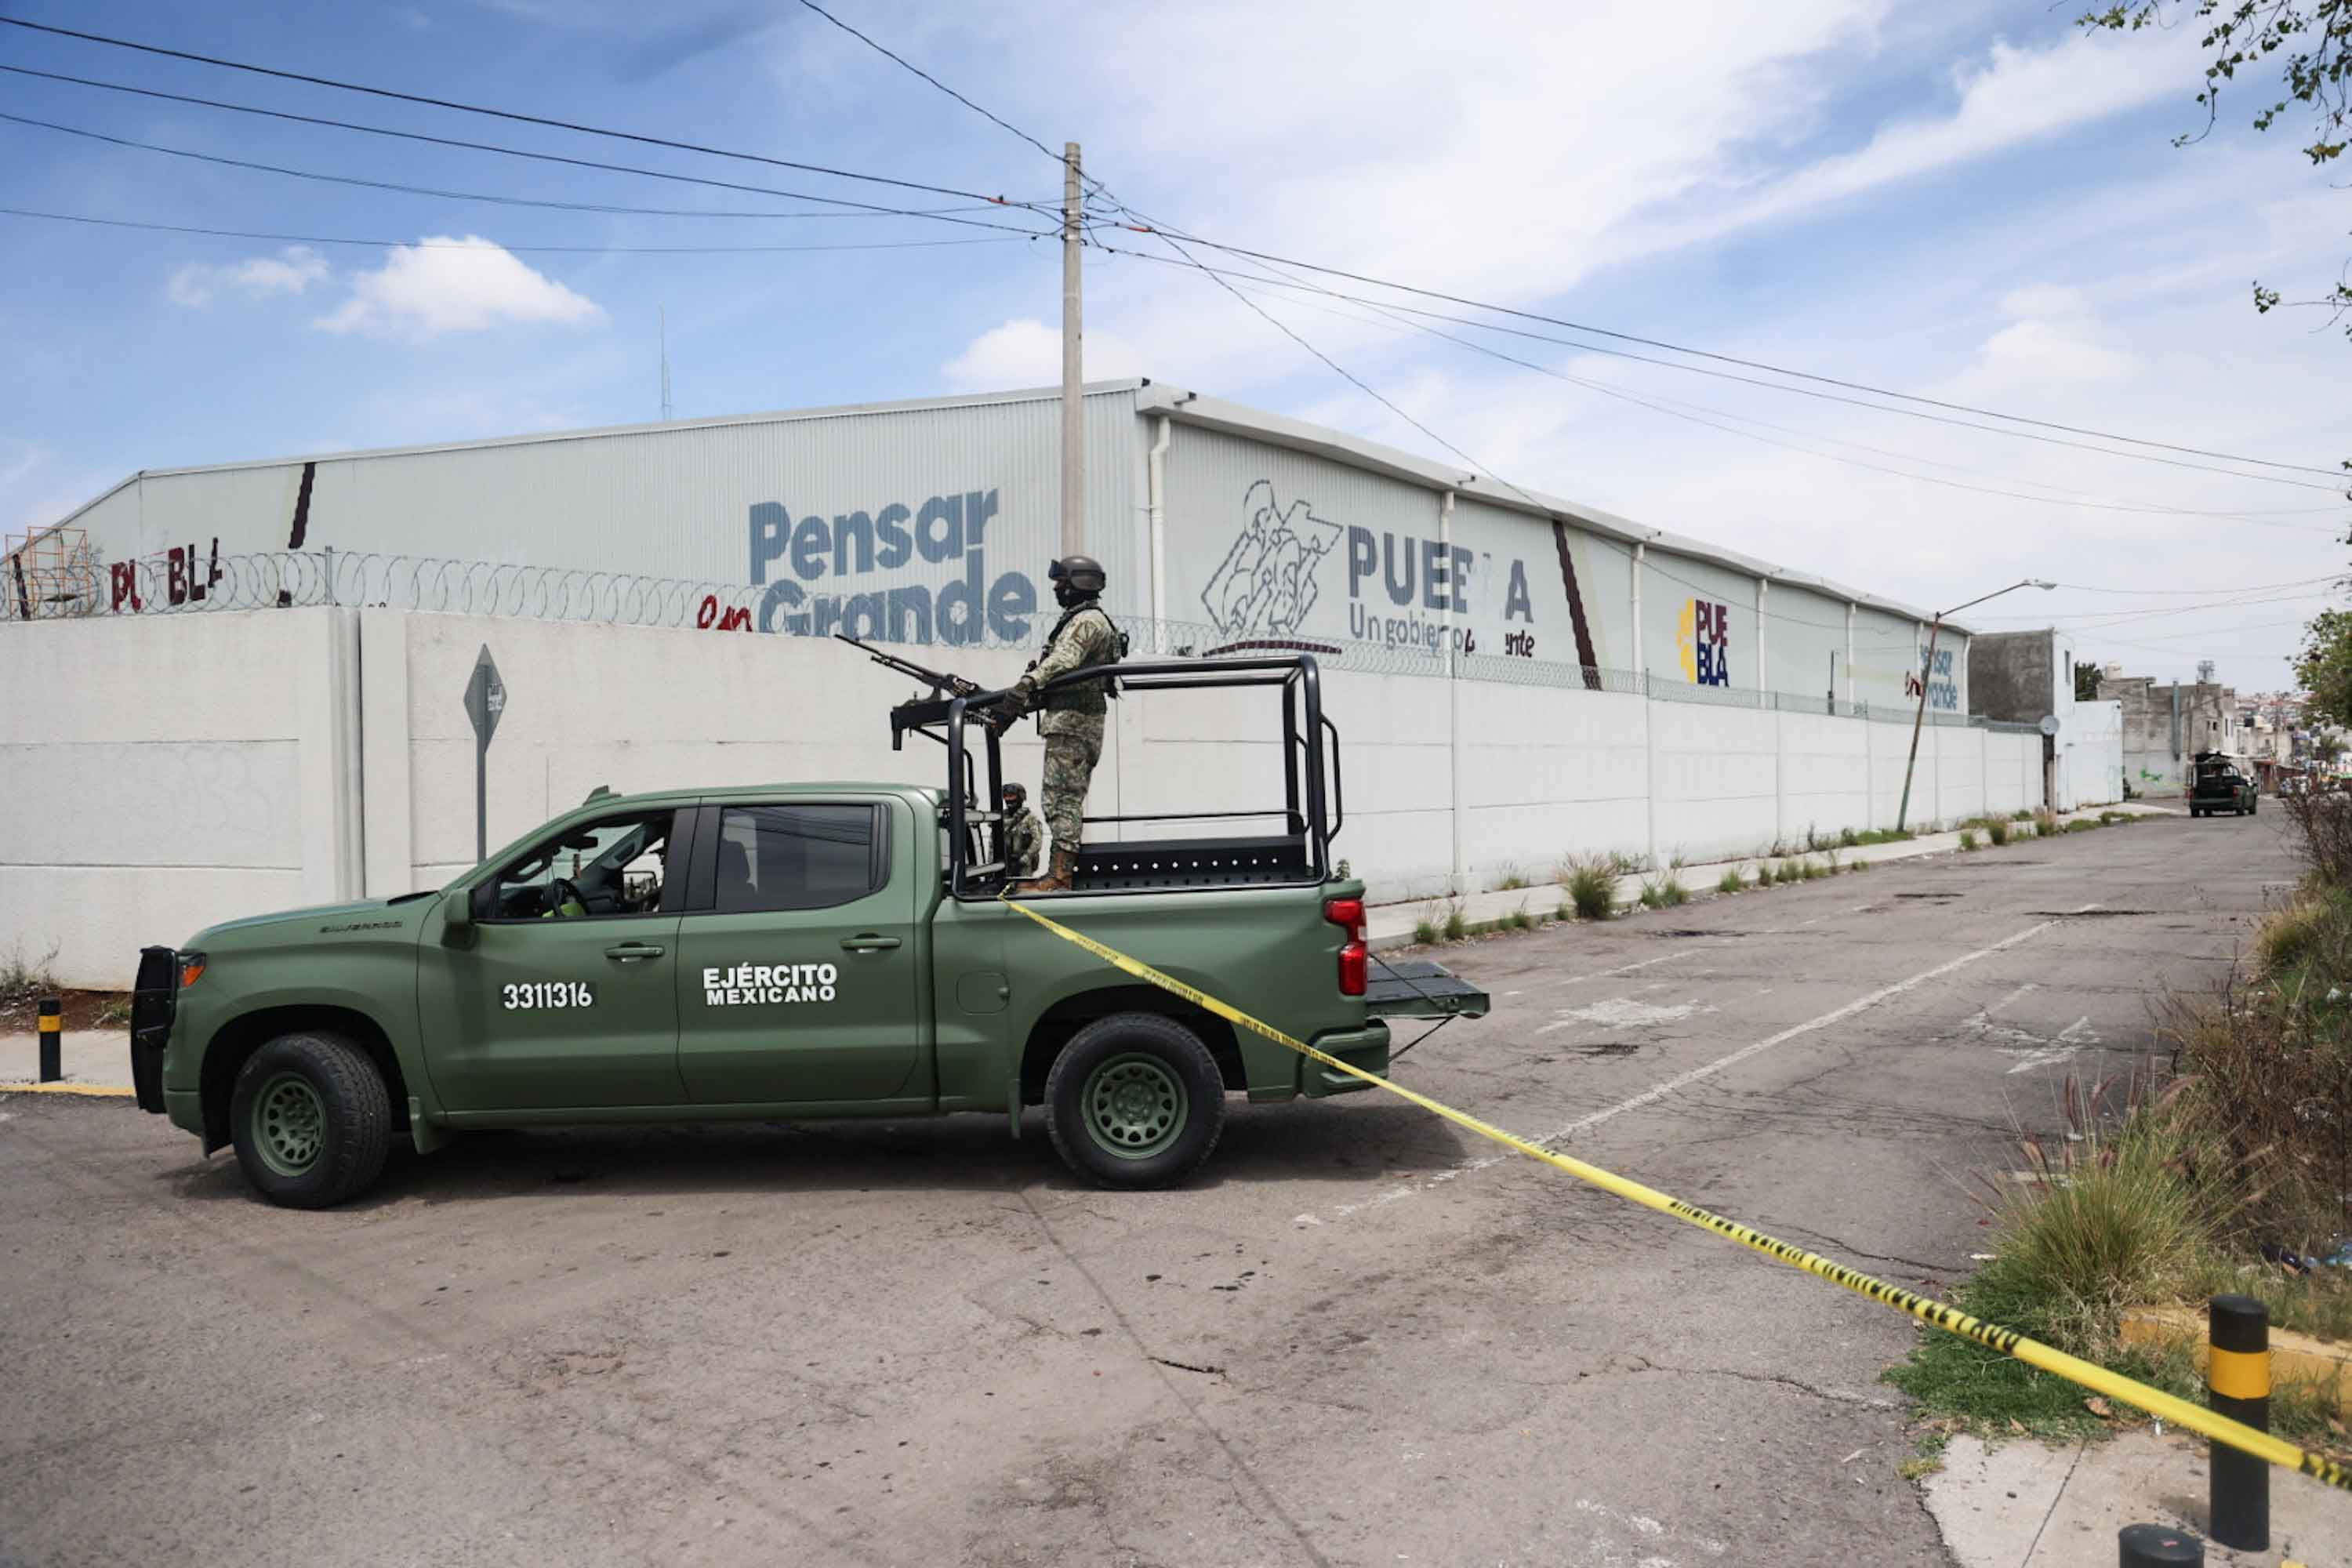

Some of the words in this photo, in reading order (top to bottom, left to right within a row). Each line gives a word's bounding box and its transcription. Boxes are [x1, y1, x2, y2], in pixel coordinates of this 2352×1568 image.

[750, 488, 998, 585] Pensar
[759, 549, 1037, 646] Grande
[1350, 602, 1381, 641] Un
[1696, 599, 1728, 647] PUE
[1697, 643, 1730, 688] BLA
[503, 982, 593, 1010] 3311316
[703, 961, 837, 989] EJÉRCITO
[706, 985, 836, 1006] MEXICANO
